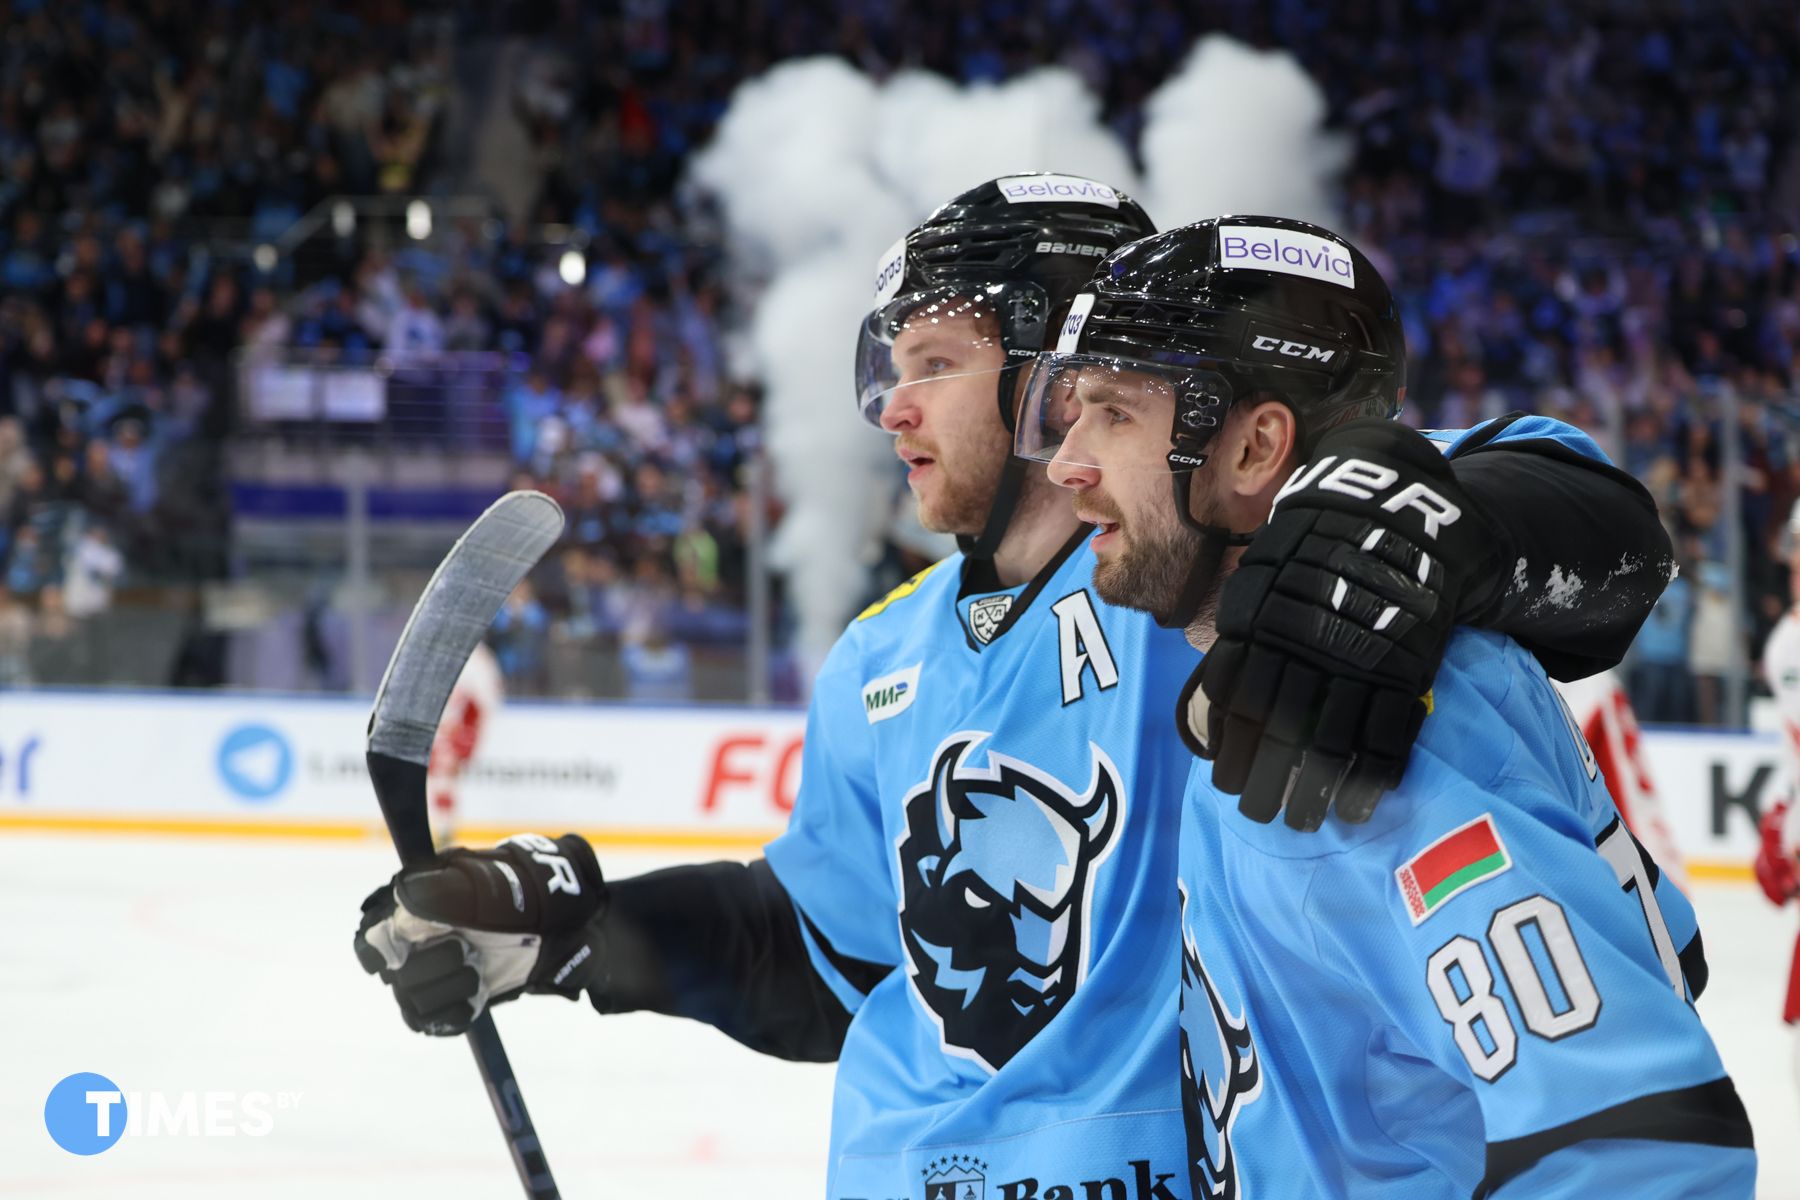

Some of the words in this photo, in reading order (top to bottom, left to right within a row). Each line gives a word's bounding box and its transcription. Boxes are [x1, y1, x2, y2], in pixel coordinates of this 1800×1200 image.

[1005, 181, 1114, 199] Belavia
[1224, 237, 1351, 278] Belavia
[1008, 349, 1037, 357] CCM
[1252, 334, 1335, 363] CCM
[1169, 454, 1203, 466] CCM
[1050, 587, 1119, 708] A
[866, 682, 908, 712] МИР
[1425, 893, 1603, 1084] 80
